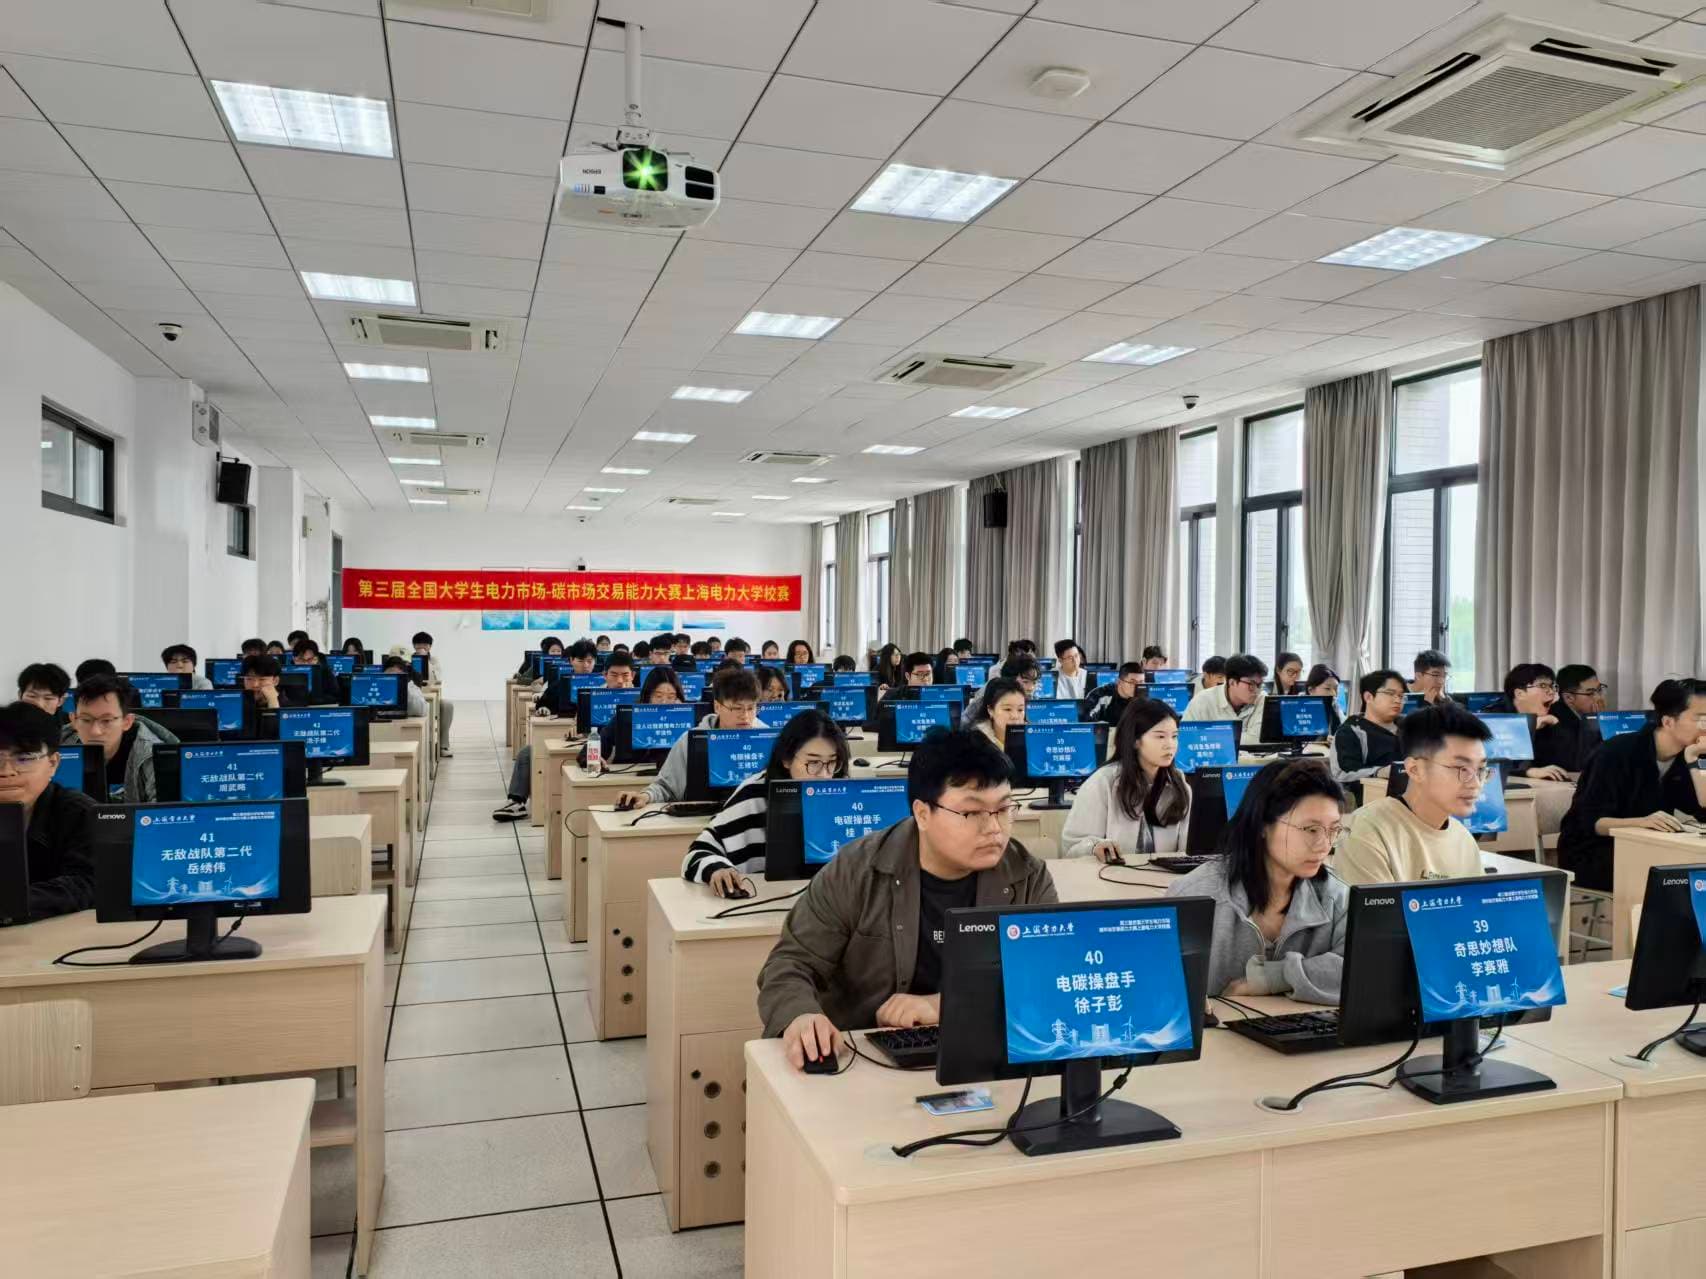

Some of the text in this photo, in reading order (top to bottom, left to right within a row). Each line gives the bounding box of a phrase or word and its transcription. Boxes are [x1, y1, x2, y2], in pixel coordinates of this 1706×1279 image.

[358, 579, 790, 601] 第三届全国大学生电力市场-碳市场交易能力大赛上海电力大学校赛
[226, 763, 238, 771] 41
[200, 772, 264, 783] 无敌战队第二代
[852, 802, 864, 811] 40
[834, 814, 881, 825] 电碳操盘手
[200, 832, 215, 843] 41
[161, 845, 252, 862] 无敌战队第二代
[187, 862, 226, 875] 岳绣伟
[1663, 878, 1688, 886] Lenovo
[1364, 896, 1395, 906] Lenovo
[959, 923, 996, 933] Lenovo
[1473, 919, 1489, 933] 39
[1454, 936, 1518, 958] 奇思妙想队
[1084, 950, 1104, 965] 40
[1471, 958, 1510, 977] 李赛雅
[1056, 970, 1136, 993] 电碳操盘手
[1074, 994, 1122, 1016] 徐子彭
